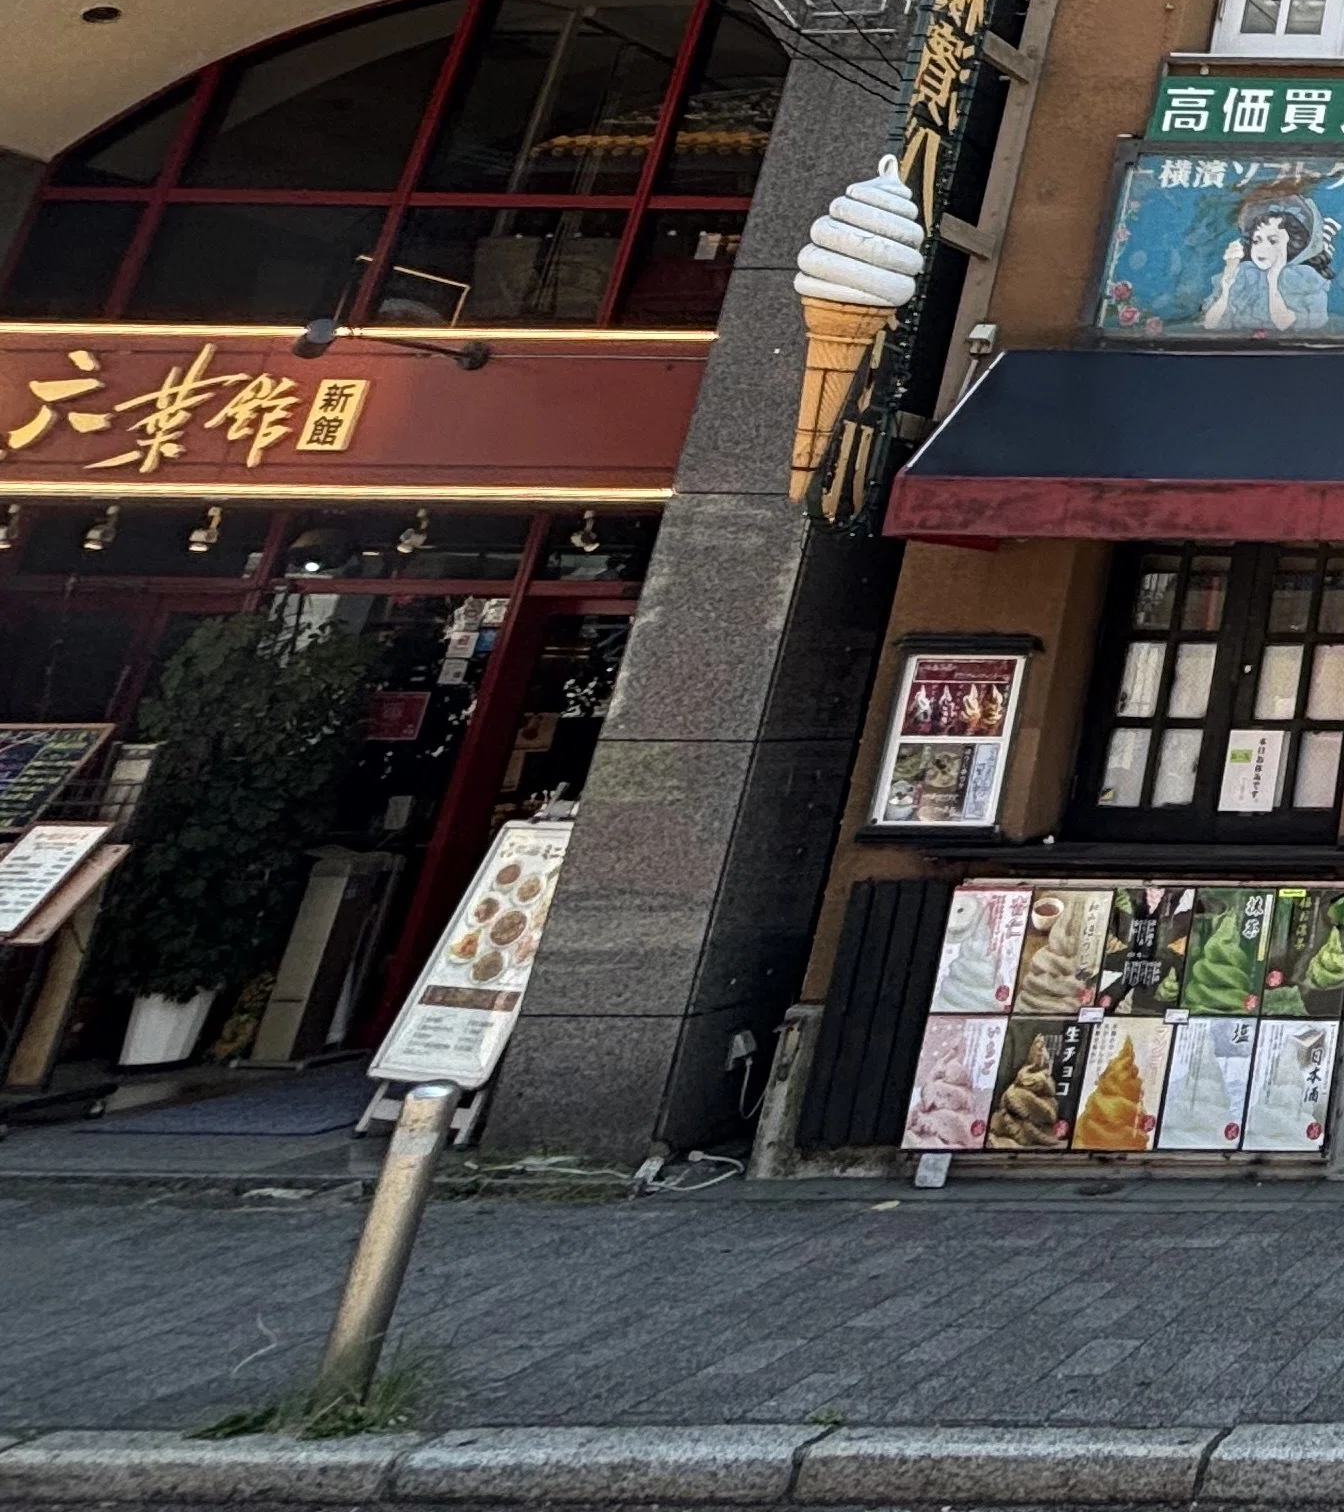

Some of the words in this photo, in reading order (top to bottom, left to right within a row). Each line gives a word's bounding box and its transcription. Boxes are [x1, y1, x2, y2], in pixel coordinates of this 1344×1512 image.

[307, 383, 354, 446] 新館
[1056, 1026, 1080, 1096] 生チョコ
[1303, 1048, 1324, 1103] 日本酒
